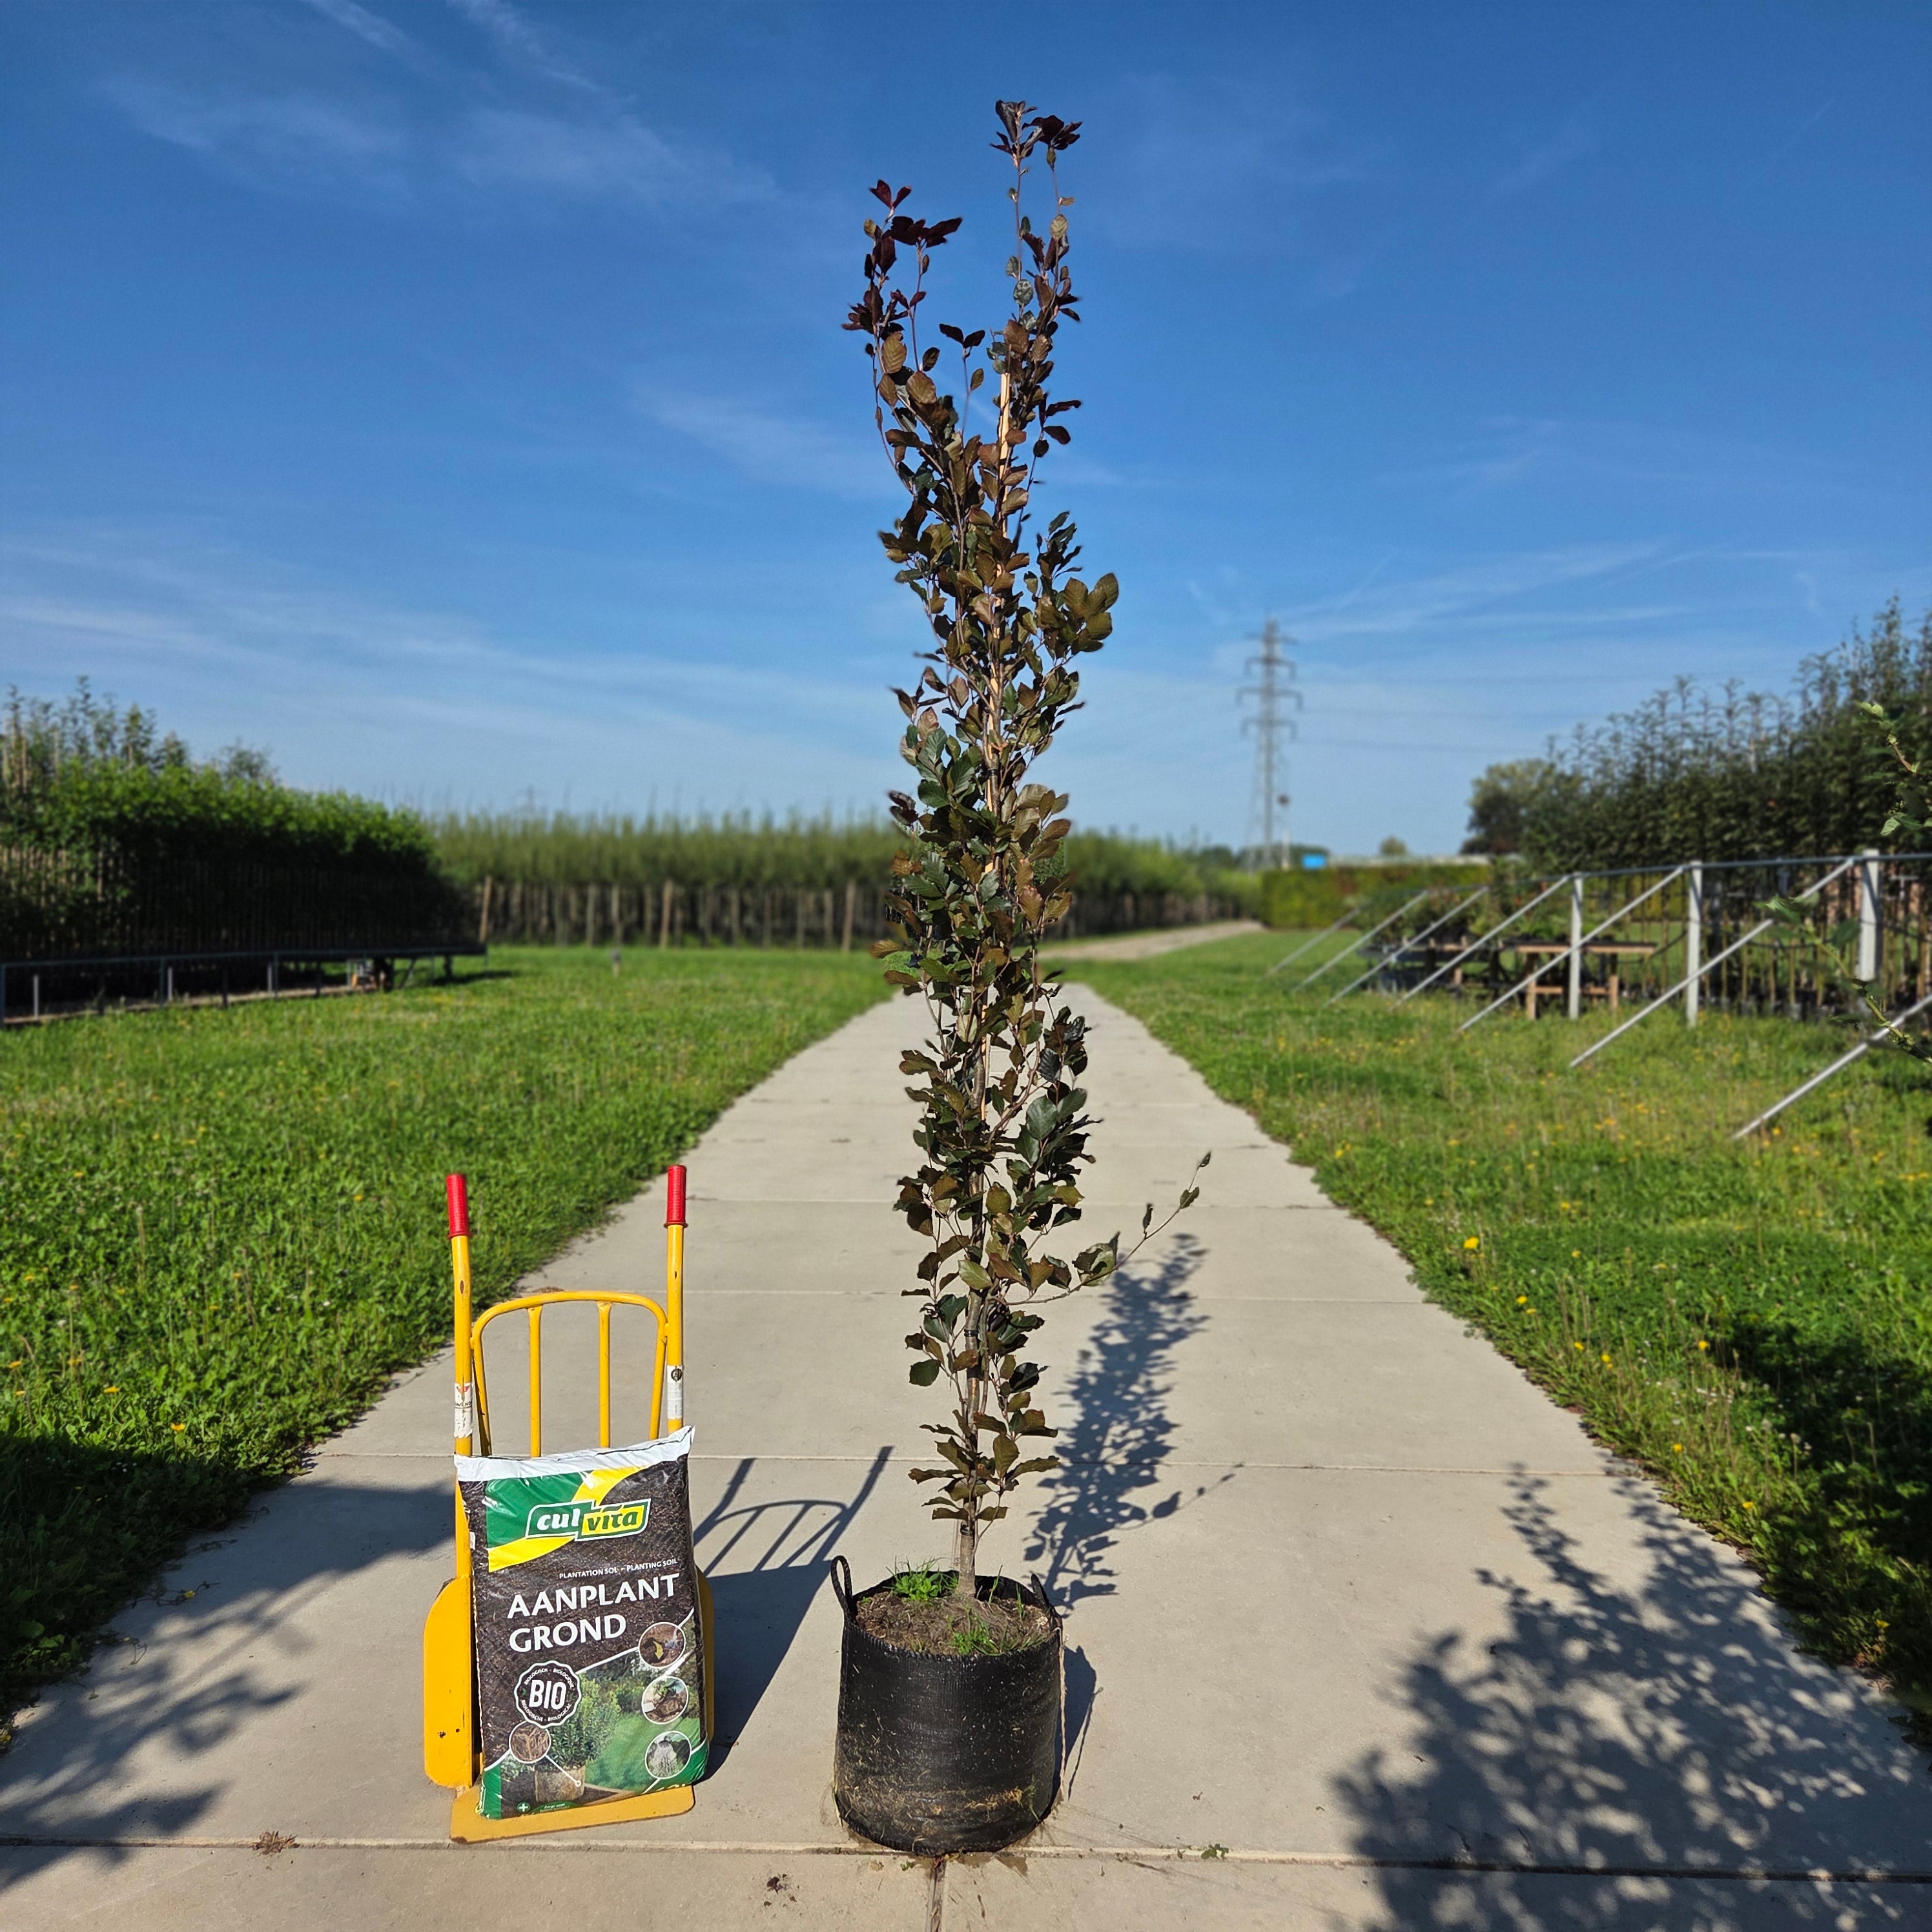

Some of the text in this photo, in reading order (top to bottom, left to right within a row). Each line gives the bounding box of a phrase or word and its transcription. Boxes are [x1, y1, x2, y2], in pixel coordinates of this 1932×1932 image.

[559, 1558, 678, 1579] PLANTATION SOL PLANTING SOIL
[507, 1573, 680, 1619] AANPLANT
[509, 1614, 626, 1652] GROND
[528, 1680, 567, 1710] BIO
